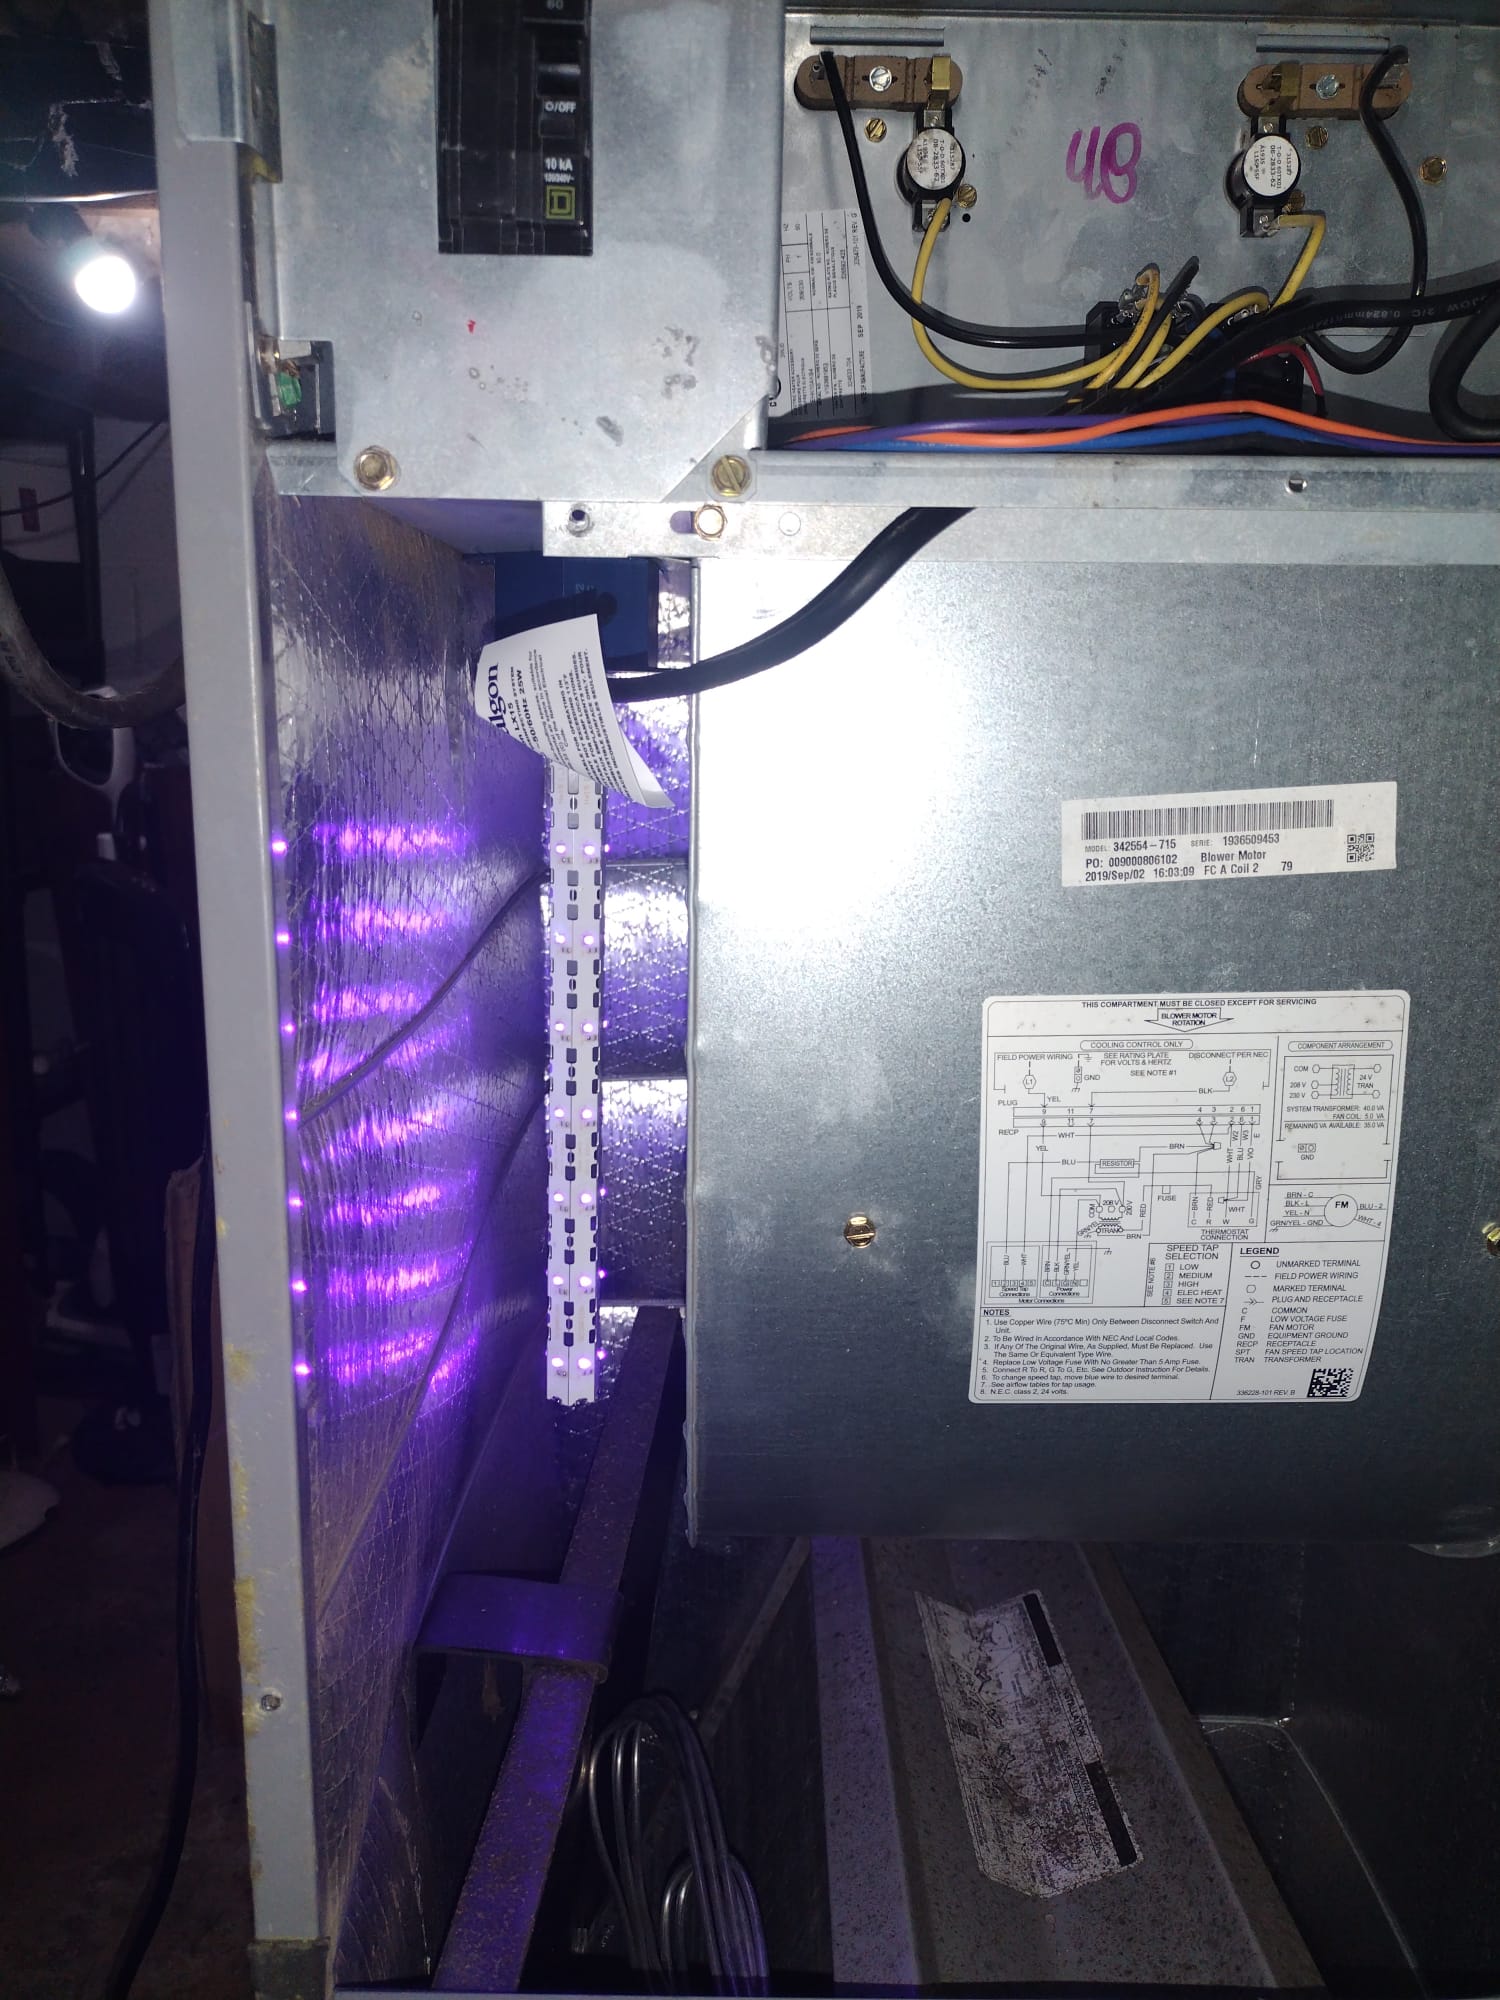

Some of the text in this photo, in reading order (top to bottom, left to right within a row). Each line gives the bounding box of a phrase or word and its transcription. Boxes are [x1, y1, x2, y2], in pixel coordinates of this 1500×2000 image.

[545, 157, 557, 170] 10
[516, 670, 525, 695] 25W
[507, 702, 520, 731] LX15
[1223, 833, 1280, 846] 1936509453
[1086, 850, 1266, 868] PO: 009000806102 Blower Motor
[1085, 861, 1293, 882] 2019/Sep/02 16:03:09 FC A Coil 2 79
[1166, 1244, 1199, 1252] SPEED
[1240, 1247, 1280, 1255] LEGEND
[1276, 1260, 1320, 1268] UNMARKED
[1275, 1272, 1297, 1280] FIELD
[1312, 1295, 1363, 1303] RECEPTACLE
[1010, 1319, 1035, 1327] Copper
[1075, 1318, 1090, 1326] Min)
[1092, 1318, 1108, 1326] Only
